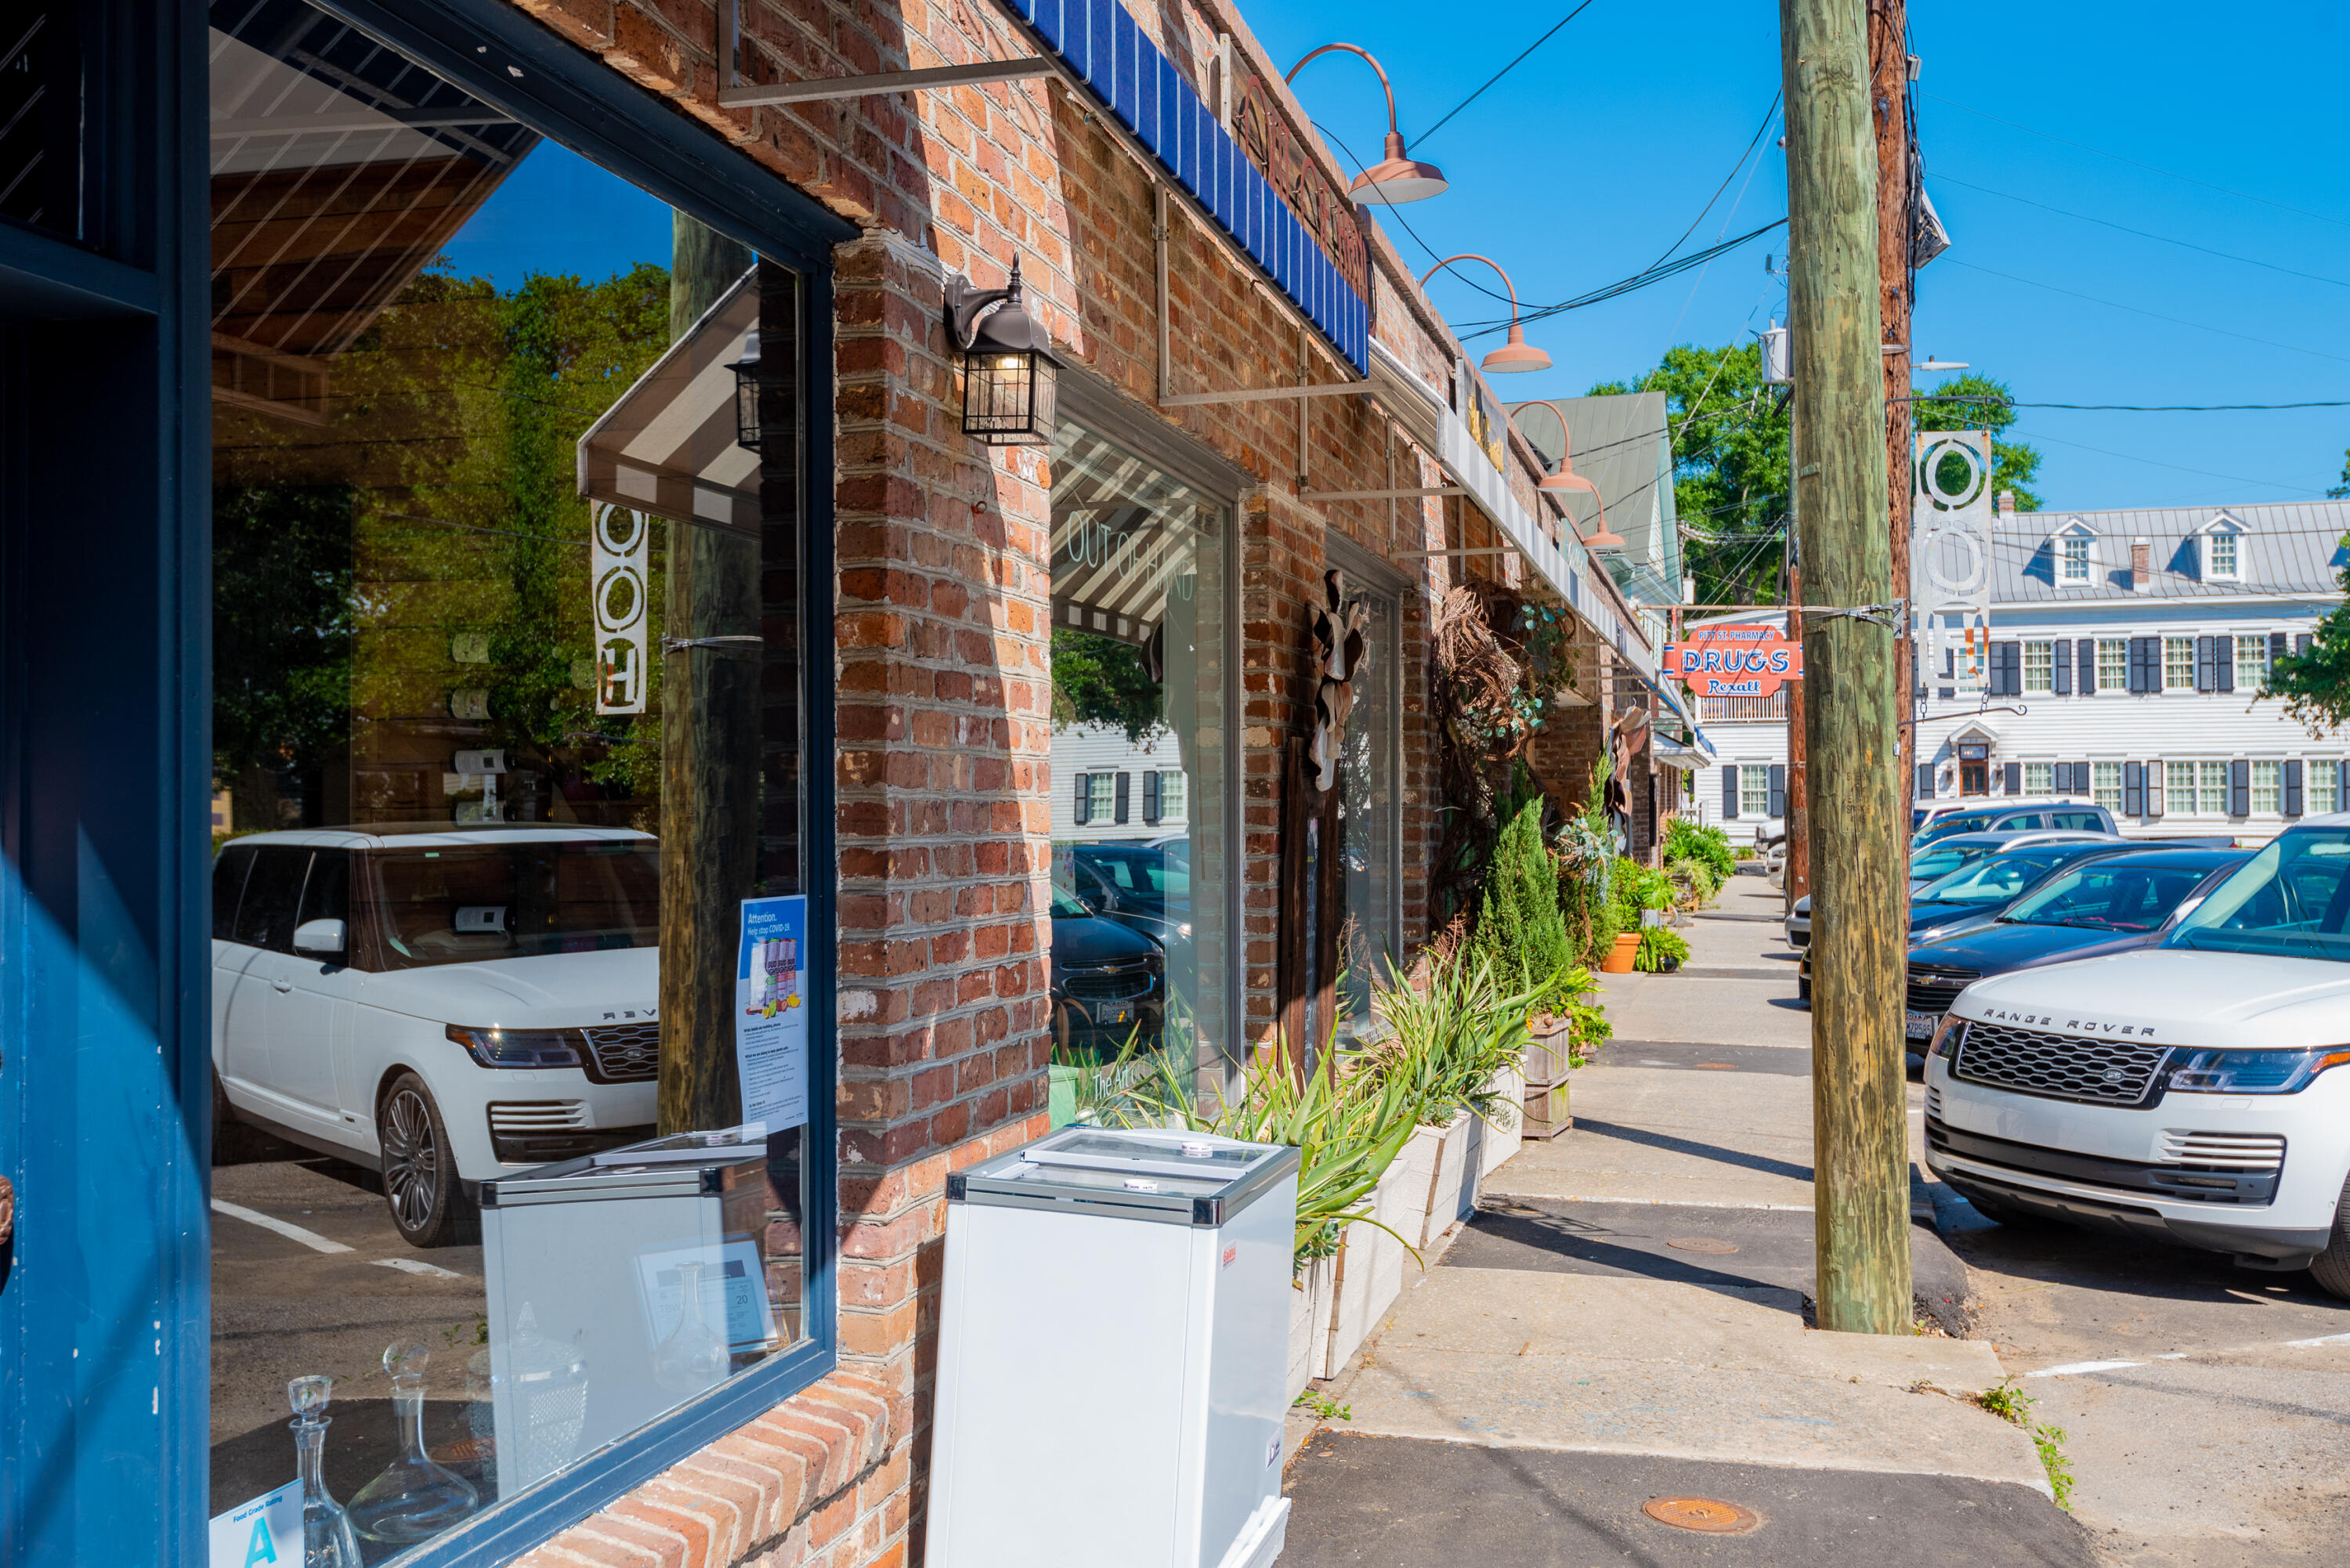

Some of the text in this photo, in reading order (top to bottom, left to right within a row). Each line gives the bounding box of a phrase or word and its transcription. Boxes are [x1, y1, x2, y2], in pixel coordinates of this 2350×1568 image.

[1067, 511, 1193, 602] OUT OF HAND
[1922, 440, 1985, 677] OOH
[1698, 630, 1776, 641] PITT ST. PHARMACY
[1682, 649, 1790, 674] DRUGS
[1708, 679, 1762, 695] Rexall
[1983, 1008, 2156, 1037] RANGE ROVER
[736, 1295, 748, 1304] 20
[233, 1512, 248, 1523] Food
[266, 1495, 283, 1508] Rating
[244, 1516, 278, 1568] A
